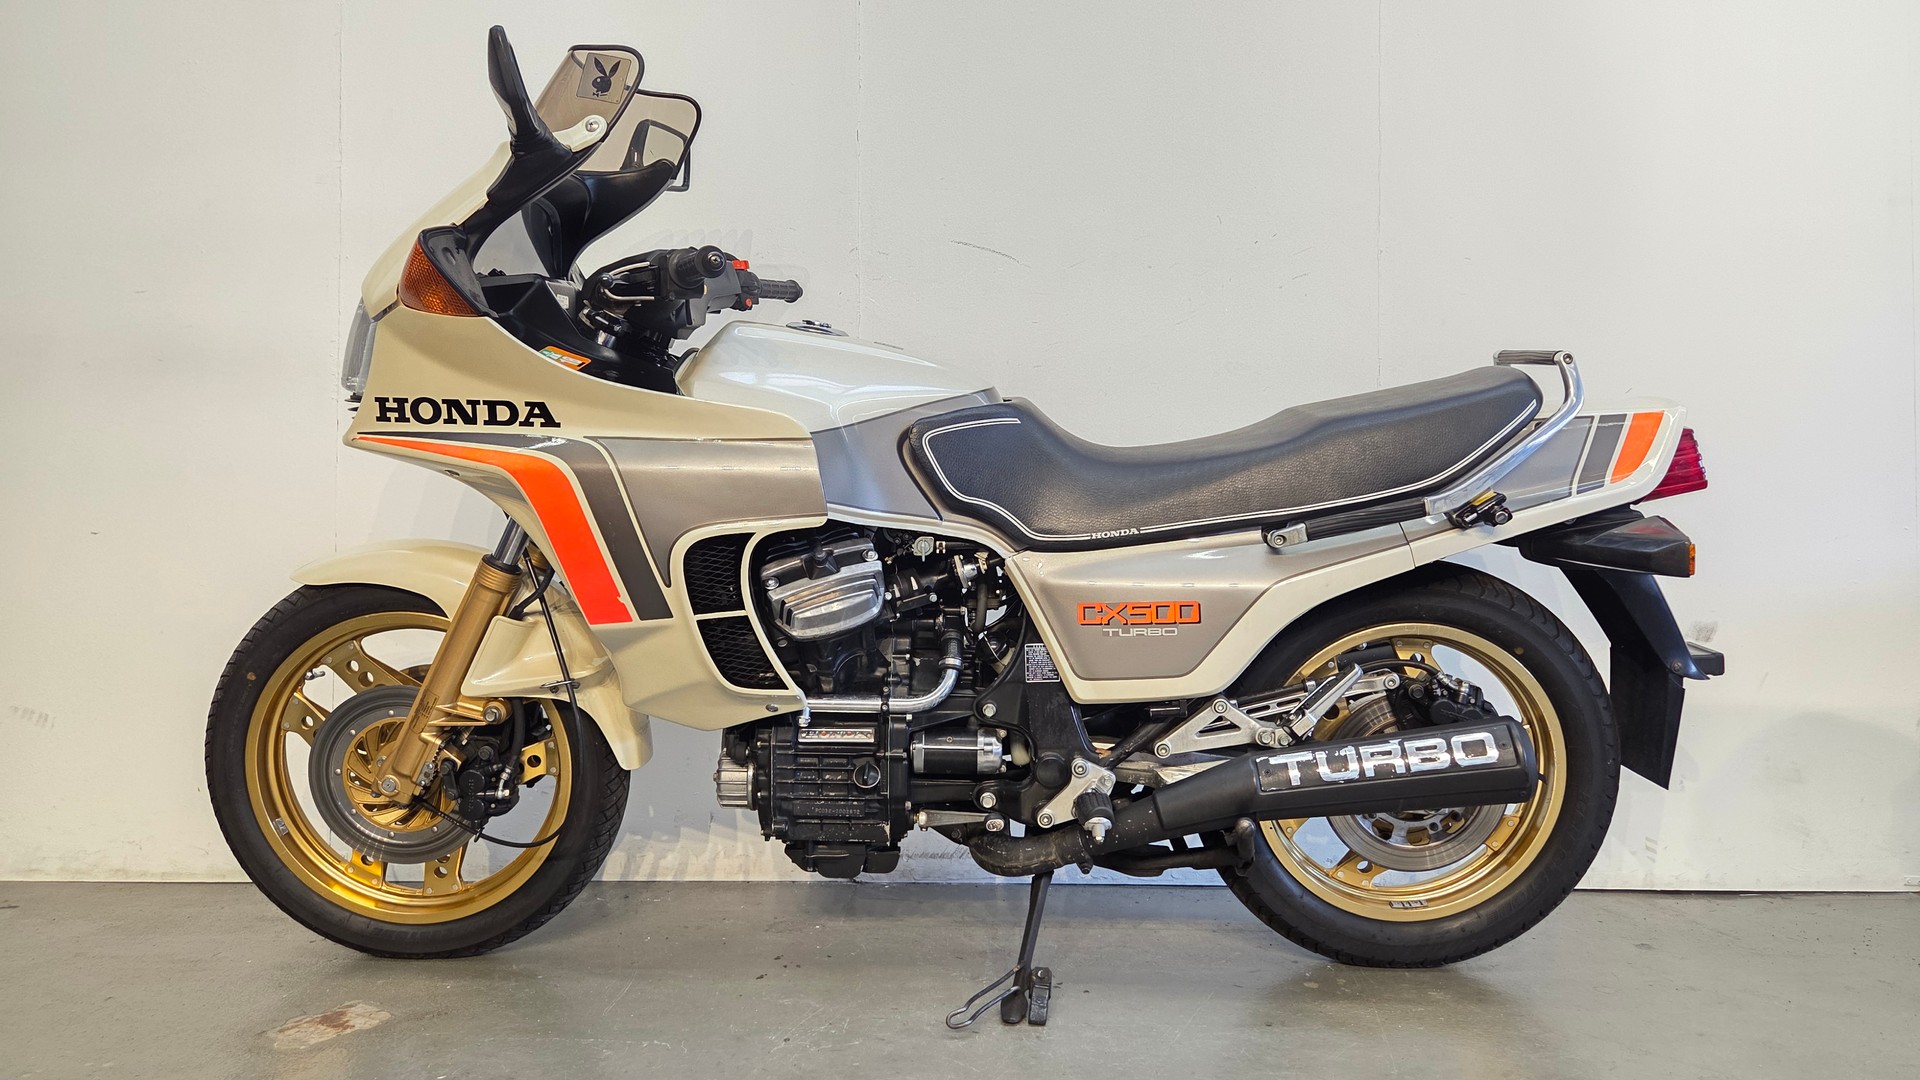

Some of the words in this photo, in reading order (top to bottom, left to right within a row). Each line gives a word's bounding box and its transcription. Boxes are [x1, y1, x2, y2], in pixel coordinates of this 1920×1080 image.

[374, 396, 561, 428] HONDA
[1091, 527, 1140, 540] HONDA
[1077, 601, 1201, 626] CX500
[1102, 628, 1178, 637] TURBO
[1268, 732, 1500, 786] TURBO
